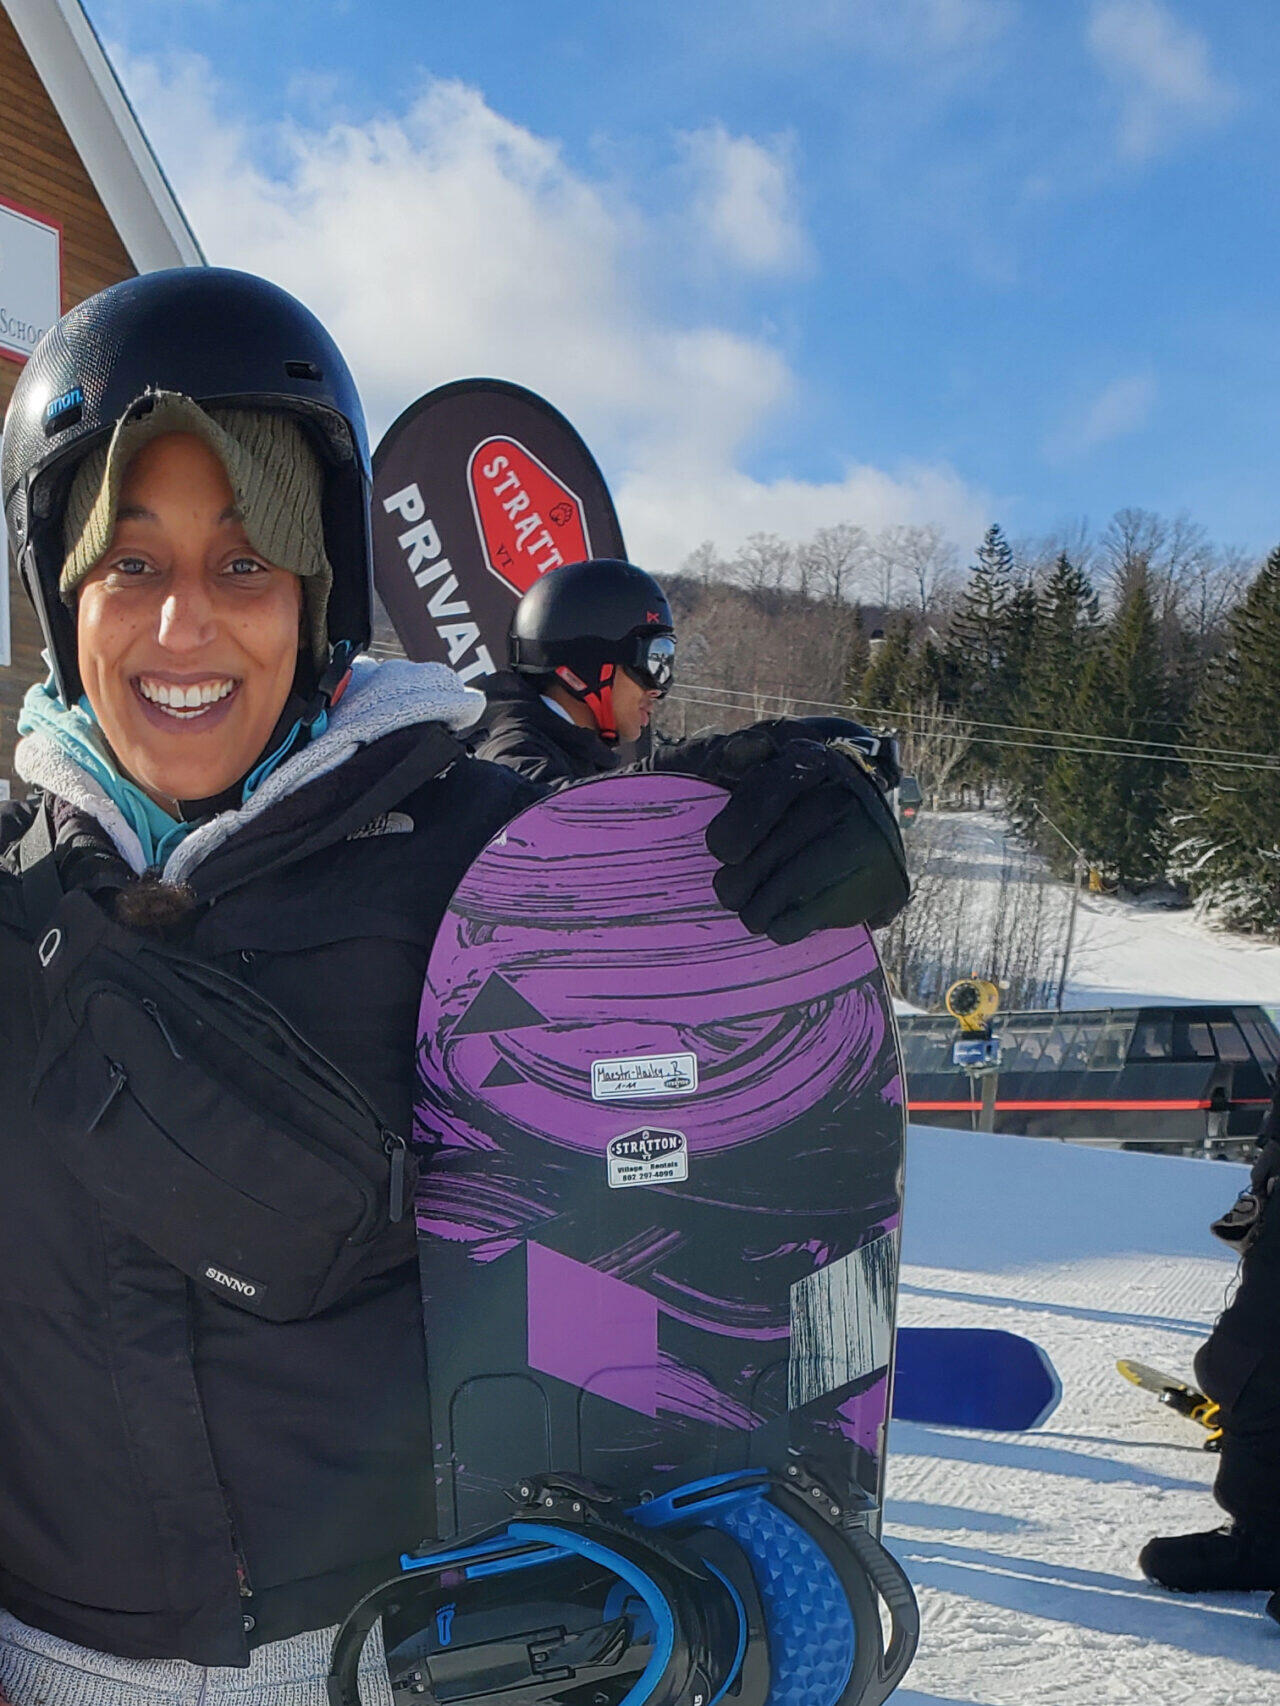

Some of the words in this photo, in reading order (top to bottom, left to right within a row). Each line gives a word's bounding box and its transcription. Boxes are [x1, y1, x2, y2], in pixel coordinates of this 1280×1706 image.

[382, 482, 497, 685] PRIVAT
[615, 1136, 678, 1155] STRATTON
[205, 1267, 256, 1297] SINNO
